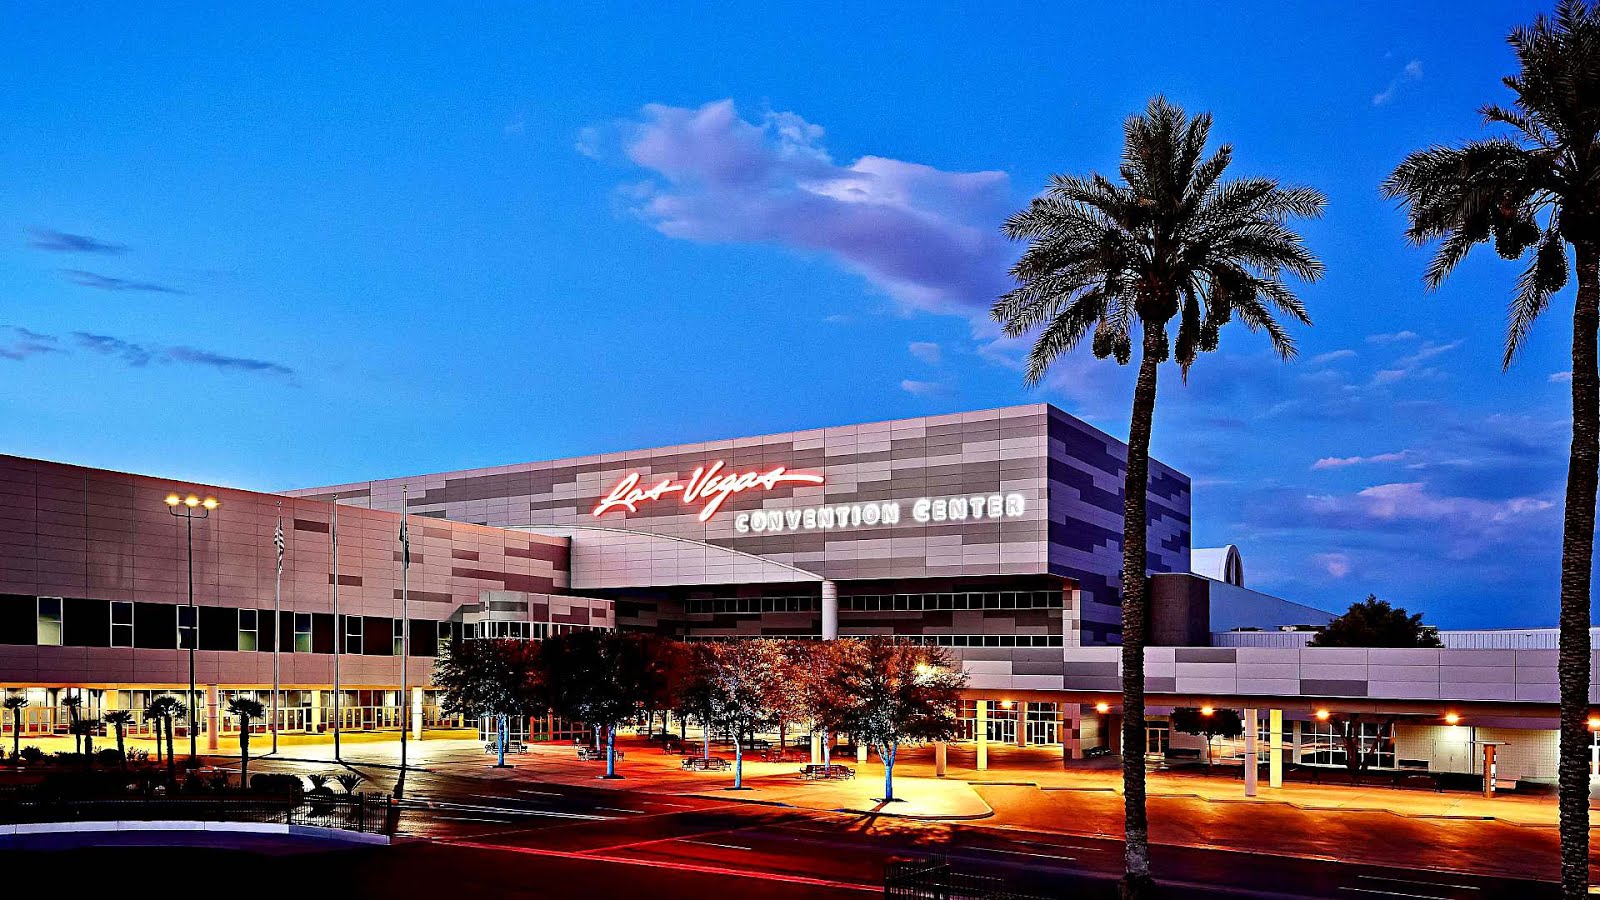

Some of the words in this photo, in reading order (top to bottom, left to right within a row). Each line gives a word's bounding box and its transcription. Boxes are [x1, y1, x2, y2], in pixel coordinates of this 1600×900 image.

[593, 472, 682, 516] Las
[683, 460, 824, 521] Vegas
[735, 502, 900, 533] CONVENTION
[913, 493, 1025, 522] CENTER
